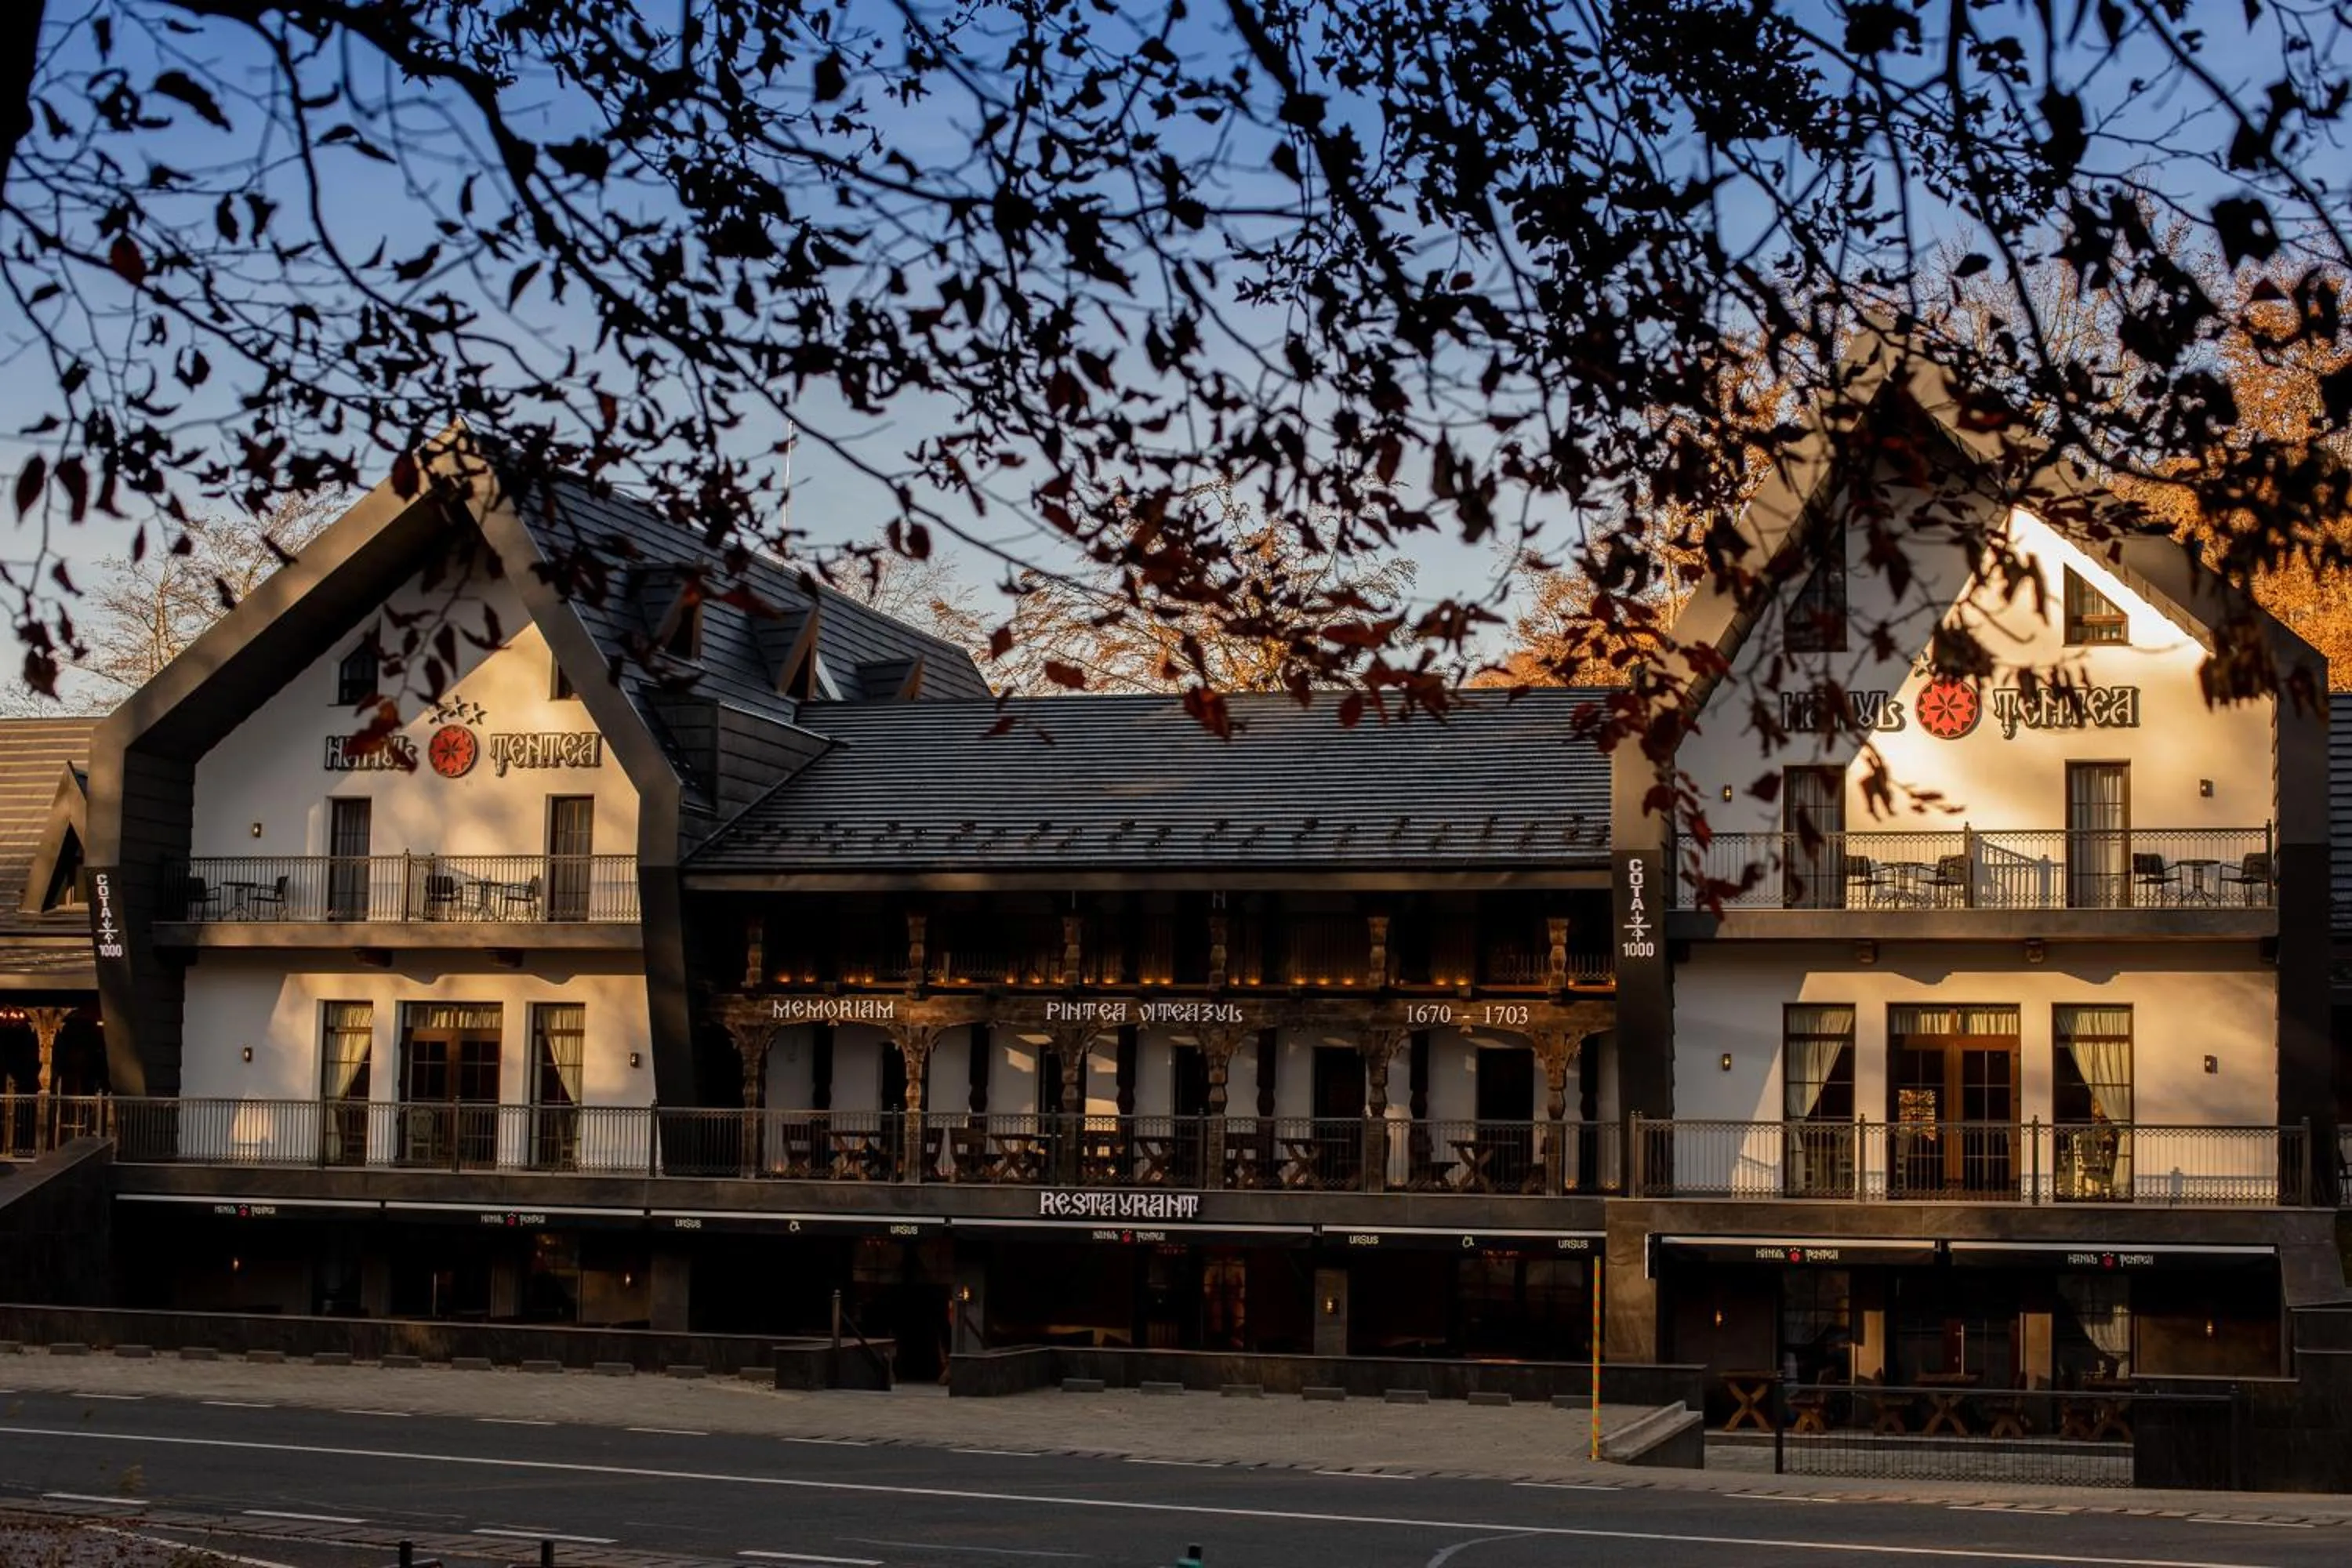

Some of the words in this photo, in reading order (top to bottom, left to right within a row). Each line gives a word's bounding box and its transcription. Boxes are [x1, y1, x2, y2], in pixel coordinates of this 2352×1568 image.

[1628, 858, 1645, 911] COTA
[96, 873, 112, 918] COTA
[98, 944, 123, 956] 1000
[1622, 942, 1654, 957] 1000
[772, 1000, 894, 1019] MEMORIAM
[1046, 1002, 1126, 1022] PINTEA
[1406, 1004, 1451, 1023] 1670
[1484, 1006, 1529, 1025] 1703
[1040, 1191, 1199, 1218] RESTAURANT
[1349, 1235, 1379, 1245] URSUS
[1558, 1240, 1588, 1250] URSUS
